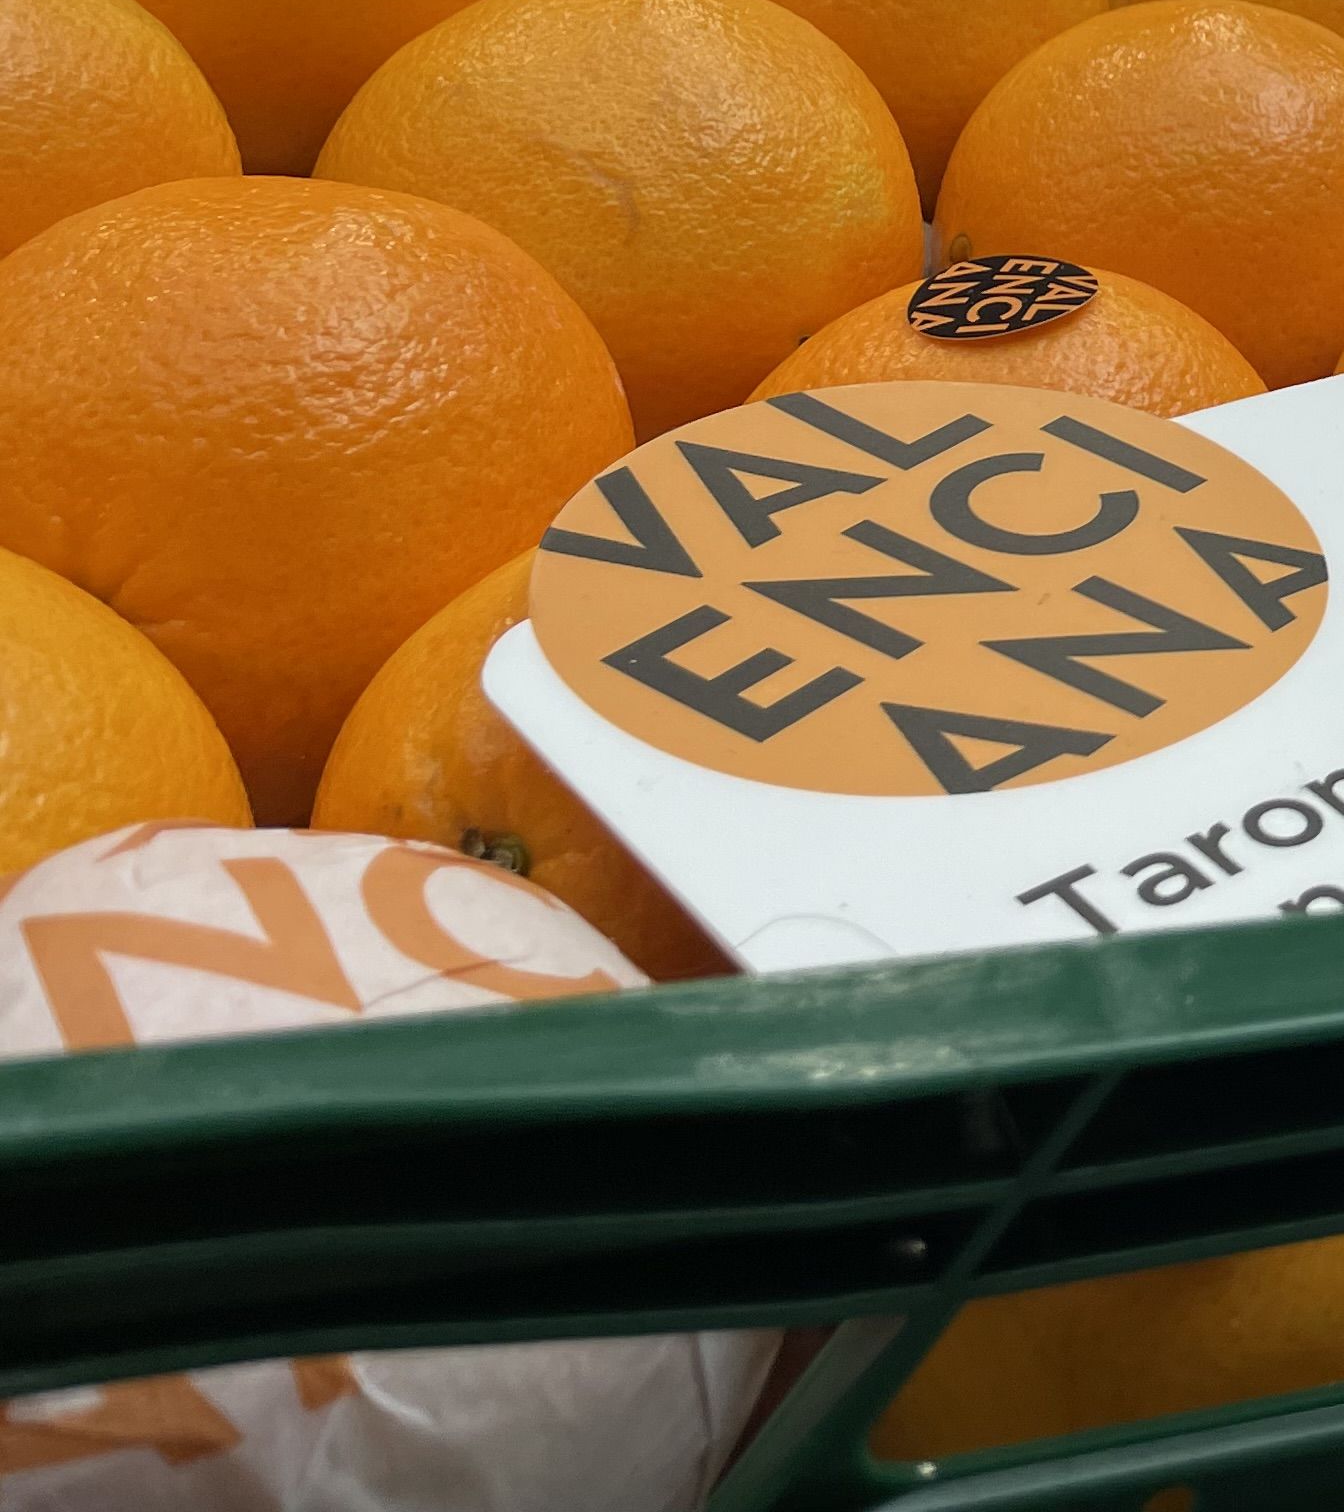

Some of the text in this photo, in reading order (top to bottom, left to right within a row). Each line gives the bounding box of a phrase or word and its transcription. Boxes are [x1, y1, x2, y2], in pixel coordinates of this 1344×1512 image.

[911, 261, 993, 332] ANA
[955, 258, 1061, 334] ENCI
[1021, 275, 1099, 322] VAL
[539, 392, 994, 579] VAL
[600, 415, 1209, 744] ENCI
[879, 525, 1329, 795] ANA
